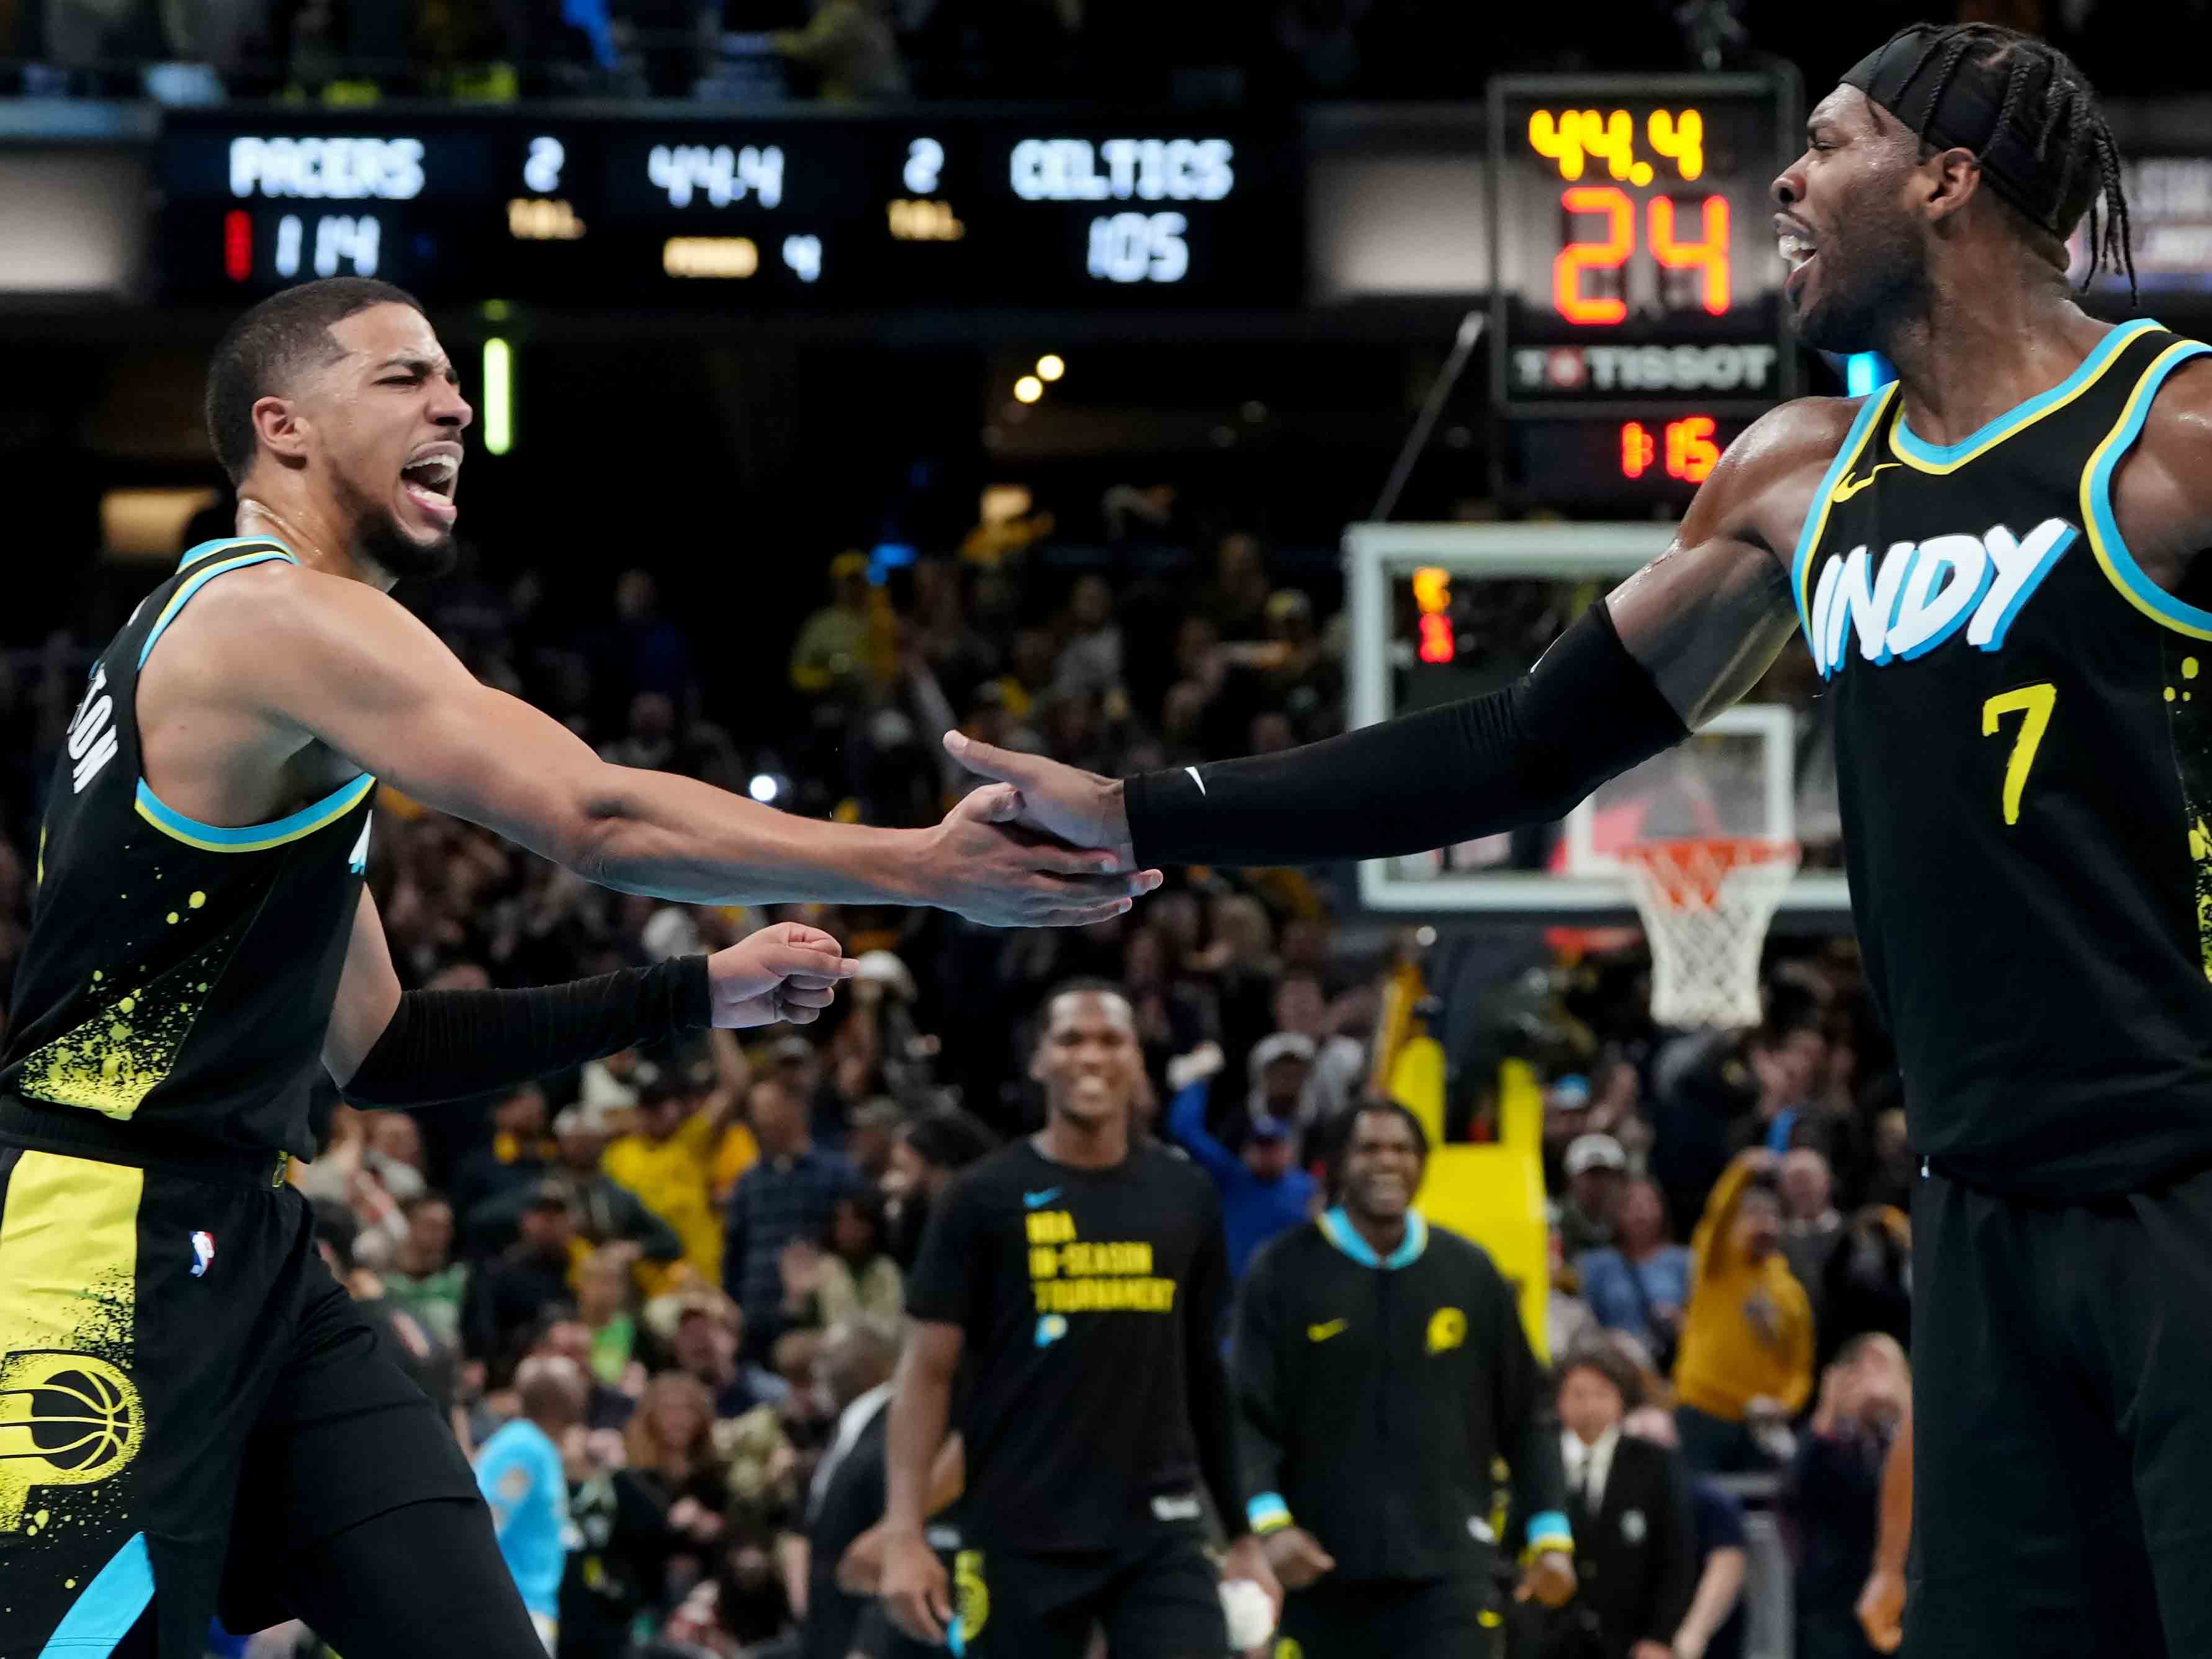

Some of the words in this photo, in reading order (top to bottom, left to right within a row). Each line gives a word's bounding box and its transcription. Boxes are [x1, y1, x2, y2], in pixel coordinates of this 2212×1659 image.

[230, 137, 425, 199] PACERS
[524, 137, 564, 192] 2
[649, 145, 784, 207] 44.4
[904, 138, 943, 193] 2
[1010, 138, 1233, 200] CELTICS
[1528, 109, 1704, 187] 44.4
[276, 214, 380, 277] 114
[1088, 212, 1188, 282] 105
[1553, 186, 1731, 325] 24
[1589, 344, 1776, 390] TISSOT
[1811, 517, 2080, 681] INDY
[1982, 683, 2056, 825] 7
